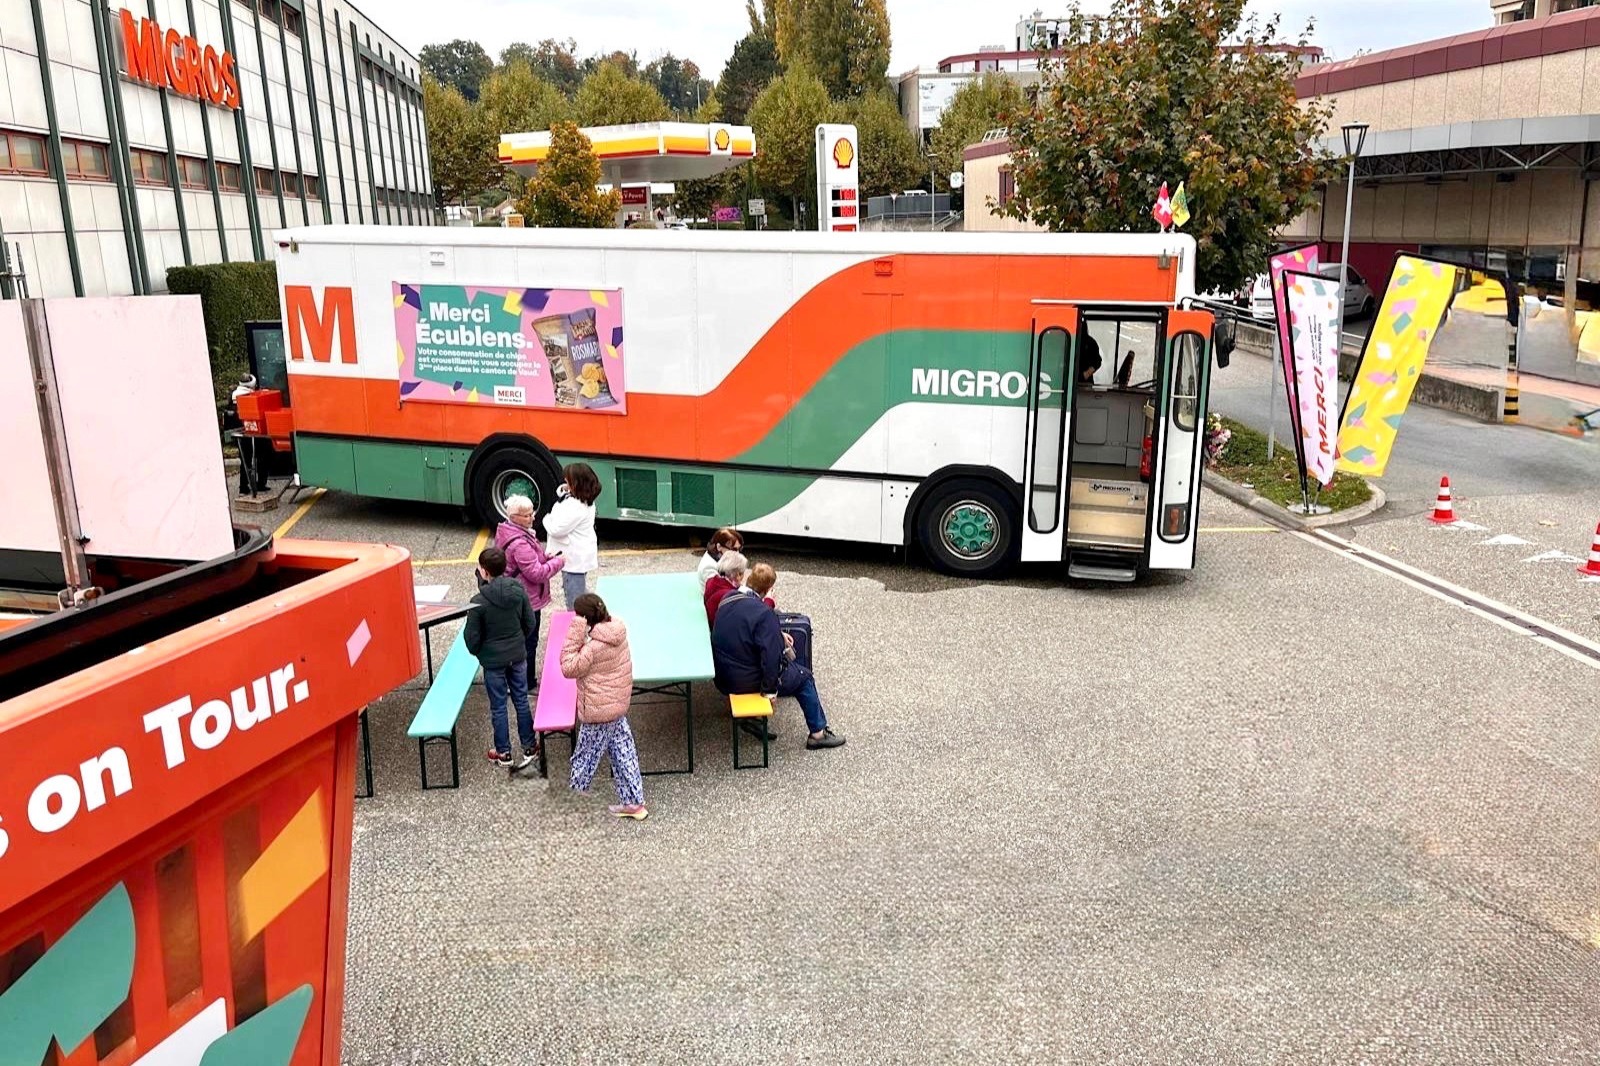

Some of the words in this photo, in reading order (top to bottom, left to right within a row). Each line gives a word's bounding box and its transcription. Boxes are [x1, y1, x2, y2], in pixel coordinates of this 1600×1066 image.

[119, 8, 240, 110] MIGROS
[284, 285, 358, 364] M
[429, 302, 491, 323] Merci
[416, 318, 533, 348] Écublens.
[417, 347, 438, 356] Votre
[438, 350, 494, 358] consommation
[494, 351, 505, 359] de
[506, 352, 527, 361] chips
[533, 361, 542, 369] le
[432, 365, 453, 373] place
[497, 390, 522, 398] MERCI
[1313, 366, 1330, 454] MERCI
[27, 746, 133, 833] on
[142, 662, 310, 770] Tour.
